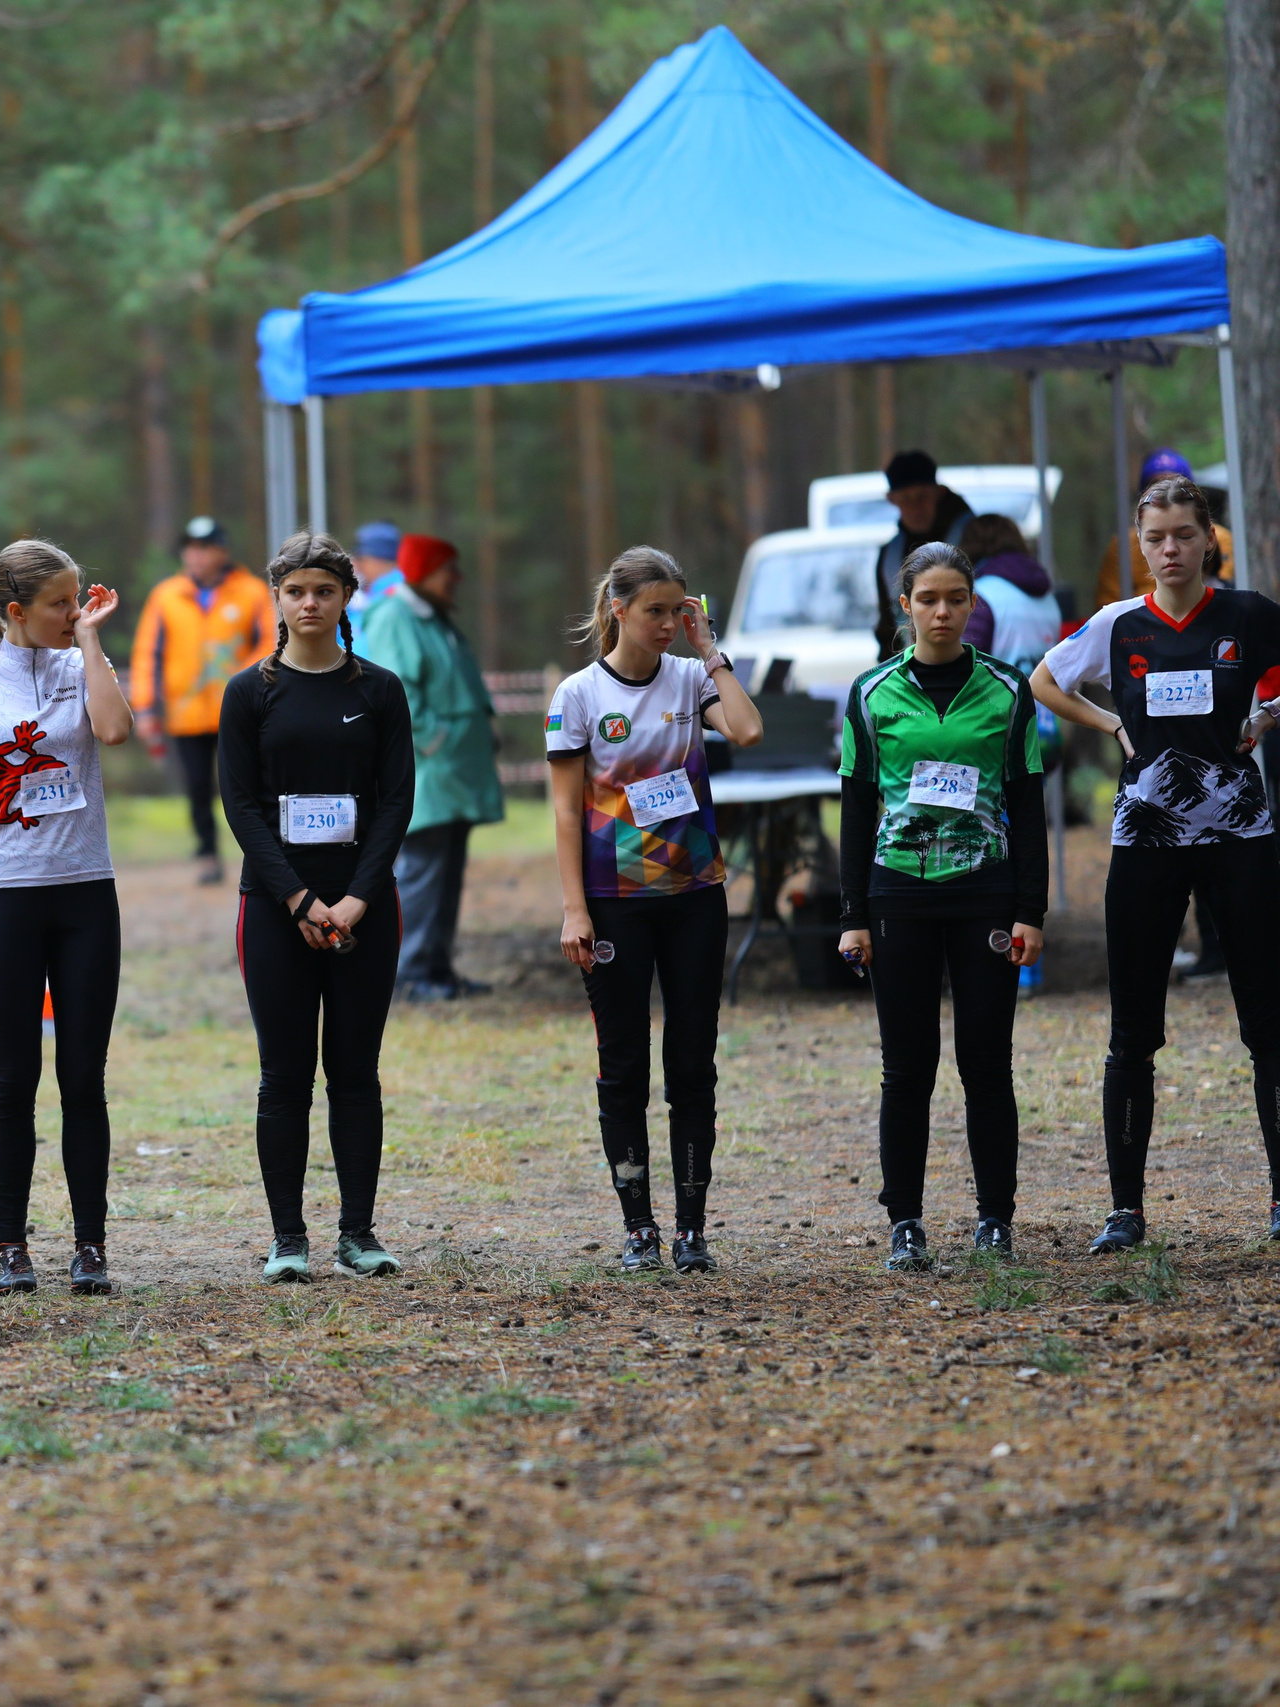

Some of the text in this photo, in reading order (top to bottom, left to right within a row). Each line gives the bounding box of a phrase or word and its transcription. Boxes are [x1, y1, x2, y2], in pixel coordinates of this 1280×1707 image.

[1164, 686, 1193, 701] 227
[38, 783, 65, 800] 231
[929, 776, 958, 794] 228
[647, 788, 675, 808] 229
[306, 813, 336, 829] 230
[1124, 1098, 1132, 1133] NORD
